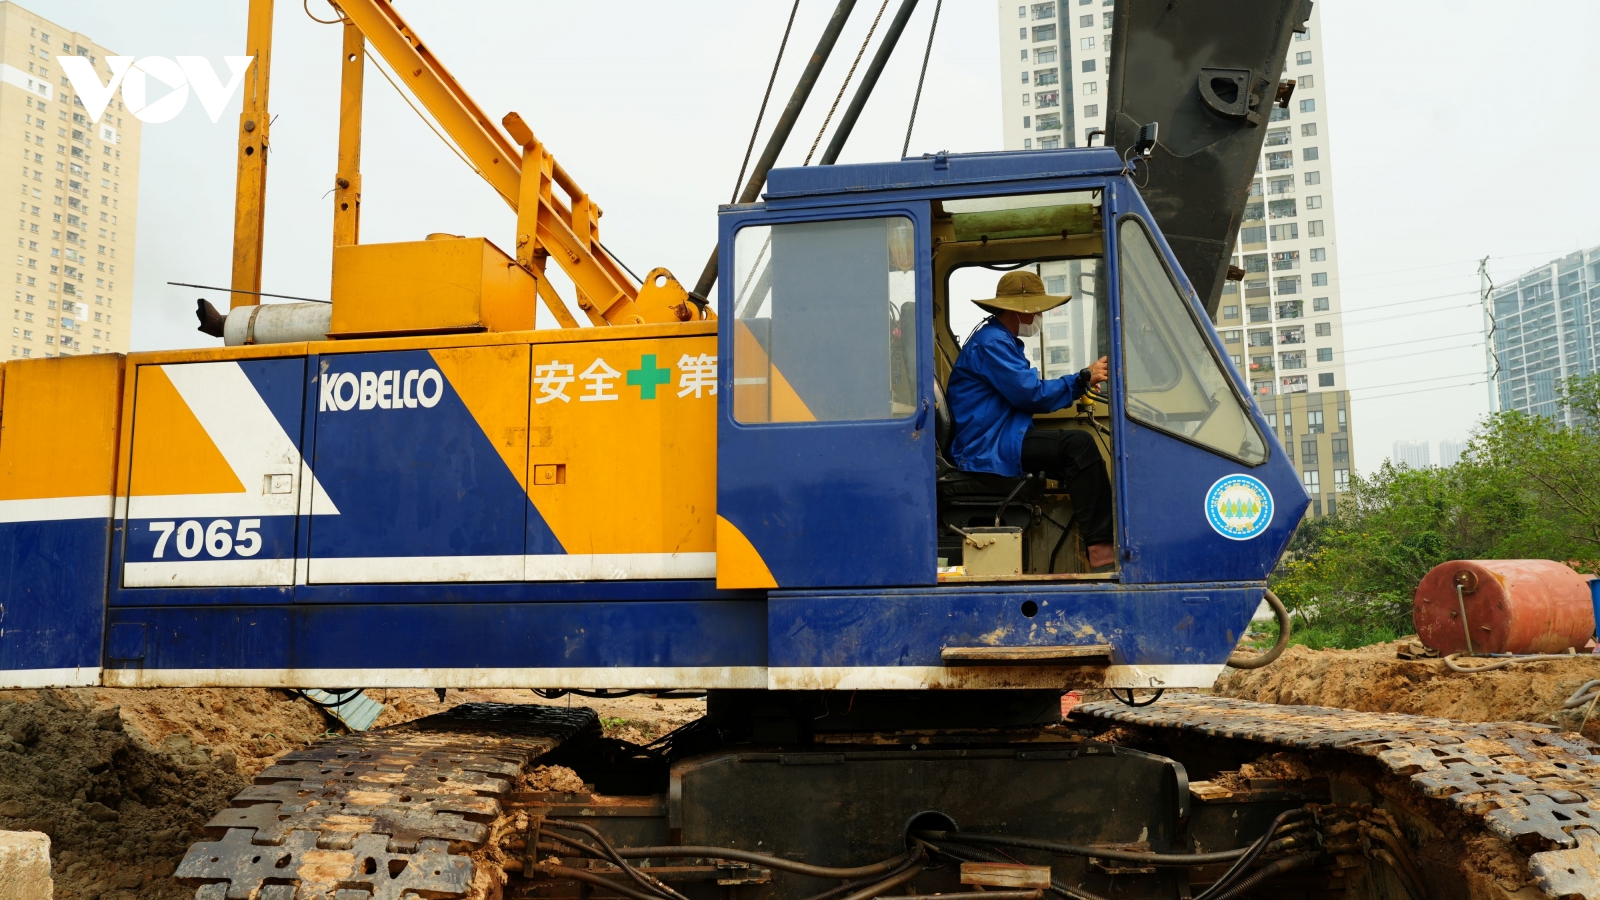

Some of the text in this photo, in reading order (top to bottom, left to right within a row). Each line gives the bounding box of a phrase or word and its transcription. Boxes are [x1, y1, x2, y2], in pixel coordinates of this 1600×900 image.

[319, 368, 444, 412] KOBELCO
[533, 353, 718, 405] 安全 第
[149, 518, 263, 559] 7065
